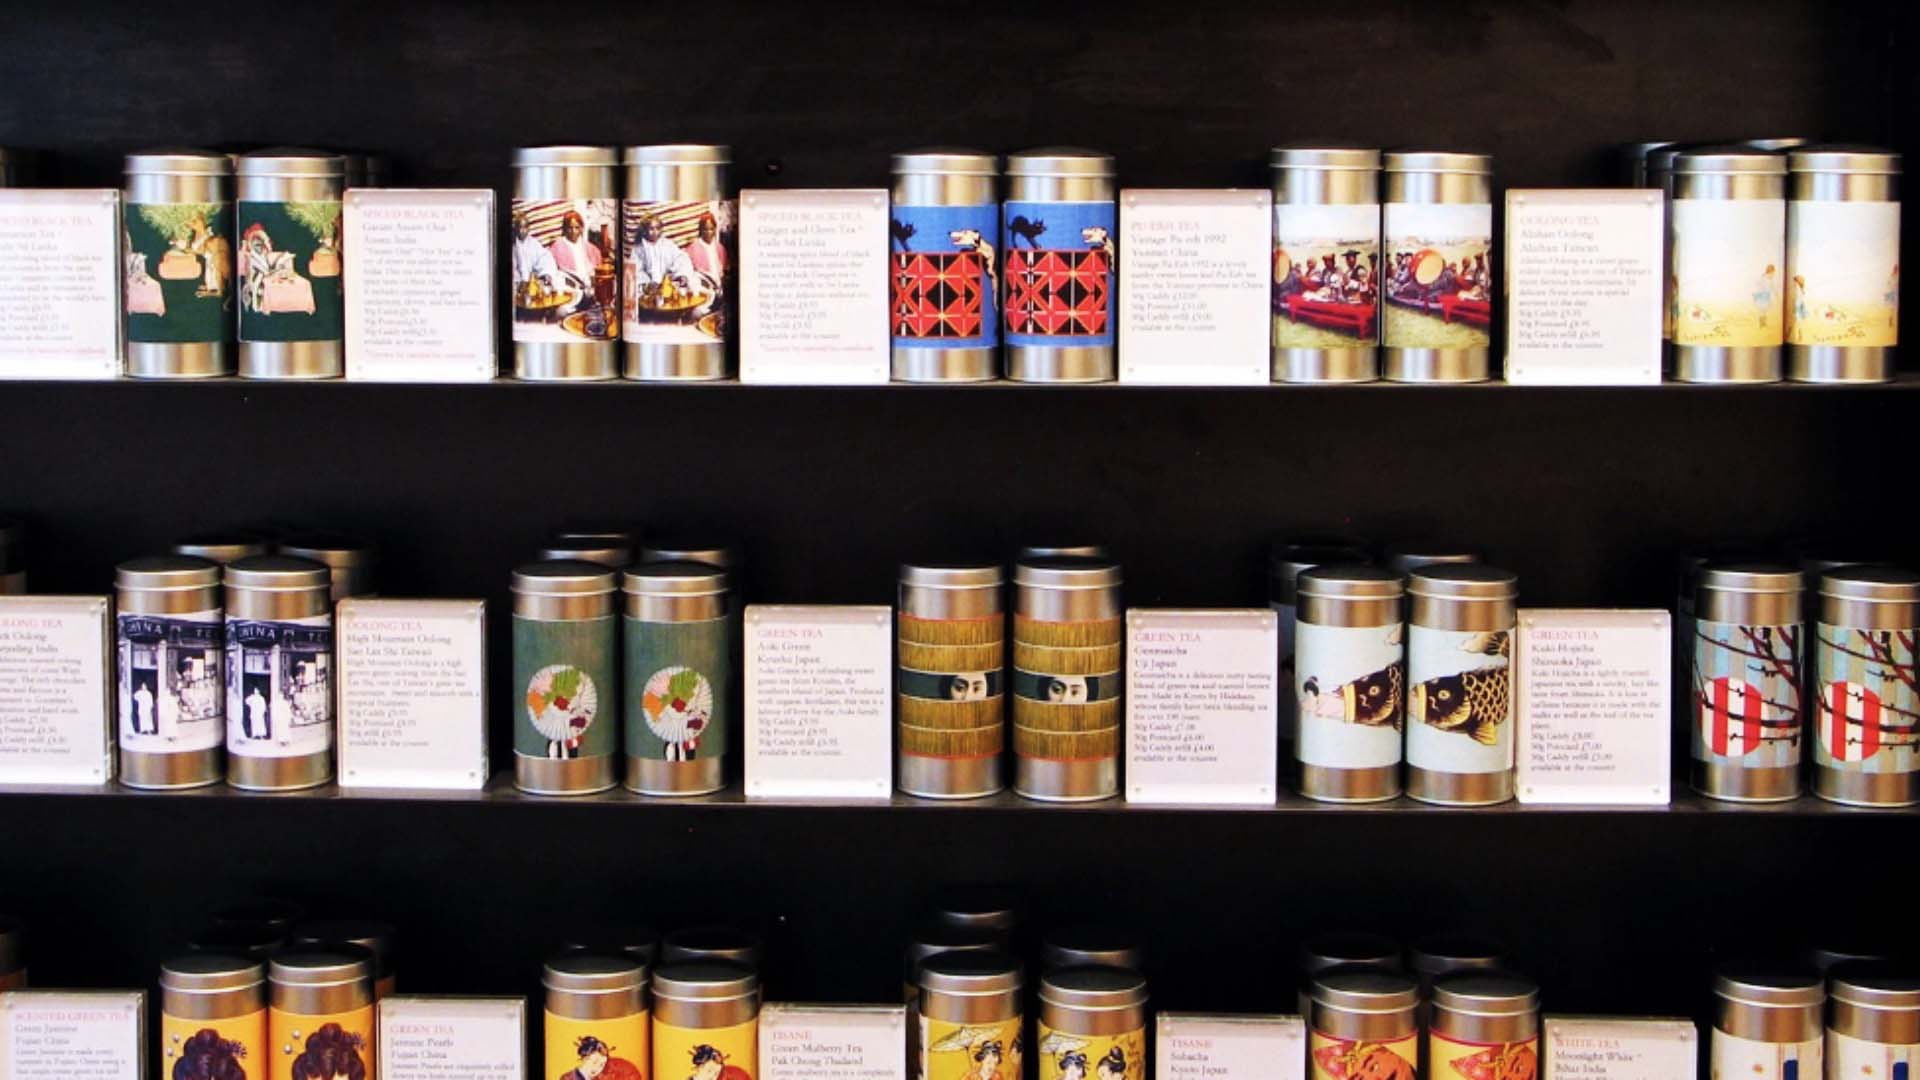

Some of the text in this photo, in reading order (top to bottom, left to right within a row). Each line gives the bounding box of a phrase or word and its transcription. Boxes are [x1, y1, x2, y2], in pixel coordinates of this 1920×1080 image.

[362, 210, 464, 219] SPICED BLACK TEA
[758, 212, 863, 222] SPICED BLACK TEA
[1519, 217, 1600, 226] OOLONG TEA
[1177, 222, 1200, 231] TEA
[41, 619, 62, 628] TEA
[346, 622, 422, 631] OOLONG TEA
[757, 629, 823, 638] GREEN TEA
[1133, 633, 1201, 642] GREEN TEA
[1531, 630, 1599, 640] GREEN TEA
[16, 1012, 129, 1021] SCENTED GREEN TEA
[390, 1025, 455, 1034] GREEN TEA
[772, 1031, 811, 1040] TISANE
[1172, 1039, 1212, 1048] TISANE
[1555, 1039, 1619, 1047] WHITE TEA
